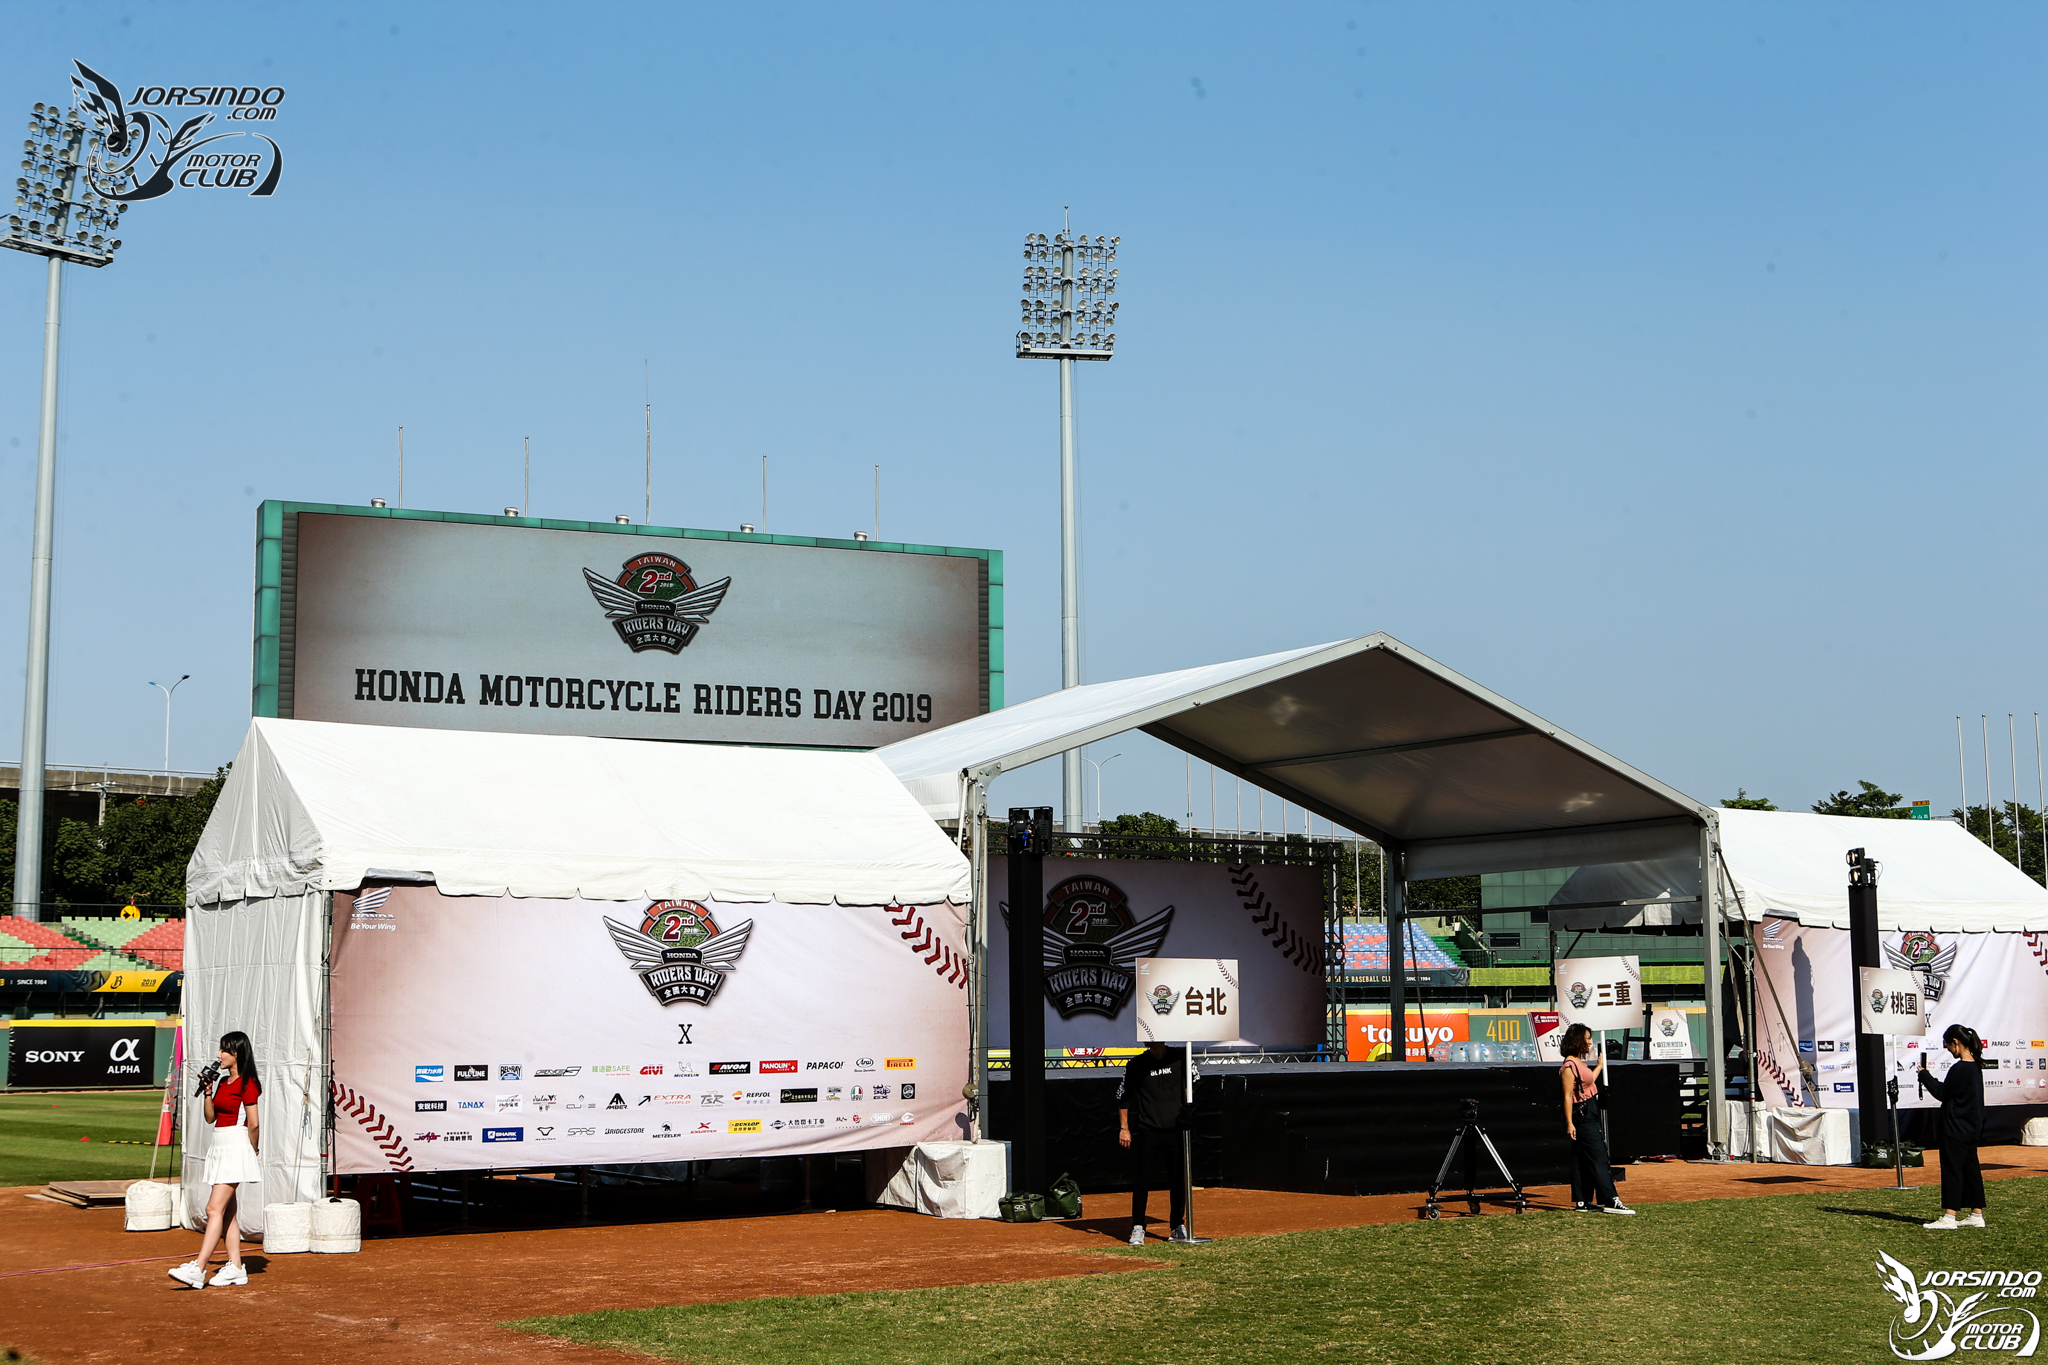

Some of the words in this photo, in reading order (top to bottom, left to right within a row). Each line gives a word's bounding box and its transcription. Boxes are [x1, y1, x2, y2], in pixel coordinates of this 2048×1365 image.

[637, 556, 677, 568] TAIWAN
[638, 569, 673, 594] 2nd
[621, 617, 664, 634] RIDERS
[667, 618, 690, 636] DAY
[636, 633, 676, 646] 全國大會師
[355, 668, 466, 705] HONDA
[479, 673, 681, 713] MOTORCYCLE
[693, 683, 801, 719] RIDERS
[813, 688, 866, 721] DAY
[872, 691, 932, 723] 2019
[1062, 881, 1110, 896] TAIWAN
[656, 900, 698, 912] TAIWAN
[1065, 900, 1107, 935] 2nd
[377, 923, 397, 932] Wing
[661, 914, 695, 942] 2nd
[141, 978, 157, 986] 2019
[648, 966, 692, 987] RIDERS
[694, 966, 719, 986] DAY
[1047, 967, 1098, 994] RIDERS
[1101, 968, 1129, 992] DAY
[1351, 975, 1380, 983] BASEBALL
[664, 985, 705, 999] 全國大會師
[1597, 980, 1632, 1006] 三重
[1065, 992, 1113, 1008] 全國大會師
[1185, 986, 1227, 1016] 台北
[1890, 991, 1918, 1015] 桃園
[677, 1024, 693, 1045] X
[1367, 1024, 1454, 1046] touyo
[1486, 1020, 1520, 1042] 400
[25, 1050, 85, 1063] SONY
[886, 1059, 914, 1068] PIRELLI
[107, 1065, 140, 1074] ALPHA
[806, 1061, 844, 1070] PAPAGO!
[457, 1070, 470, 1078] FULL
[458, 1101, 485, 1109] TANAX
[604, 1127, 645, 1135] BRIDGESTONE
